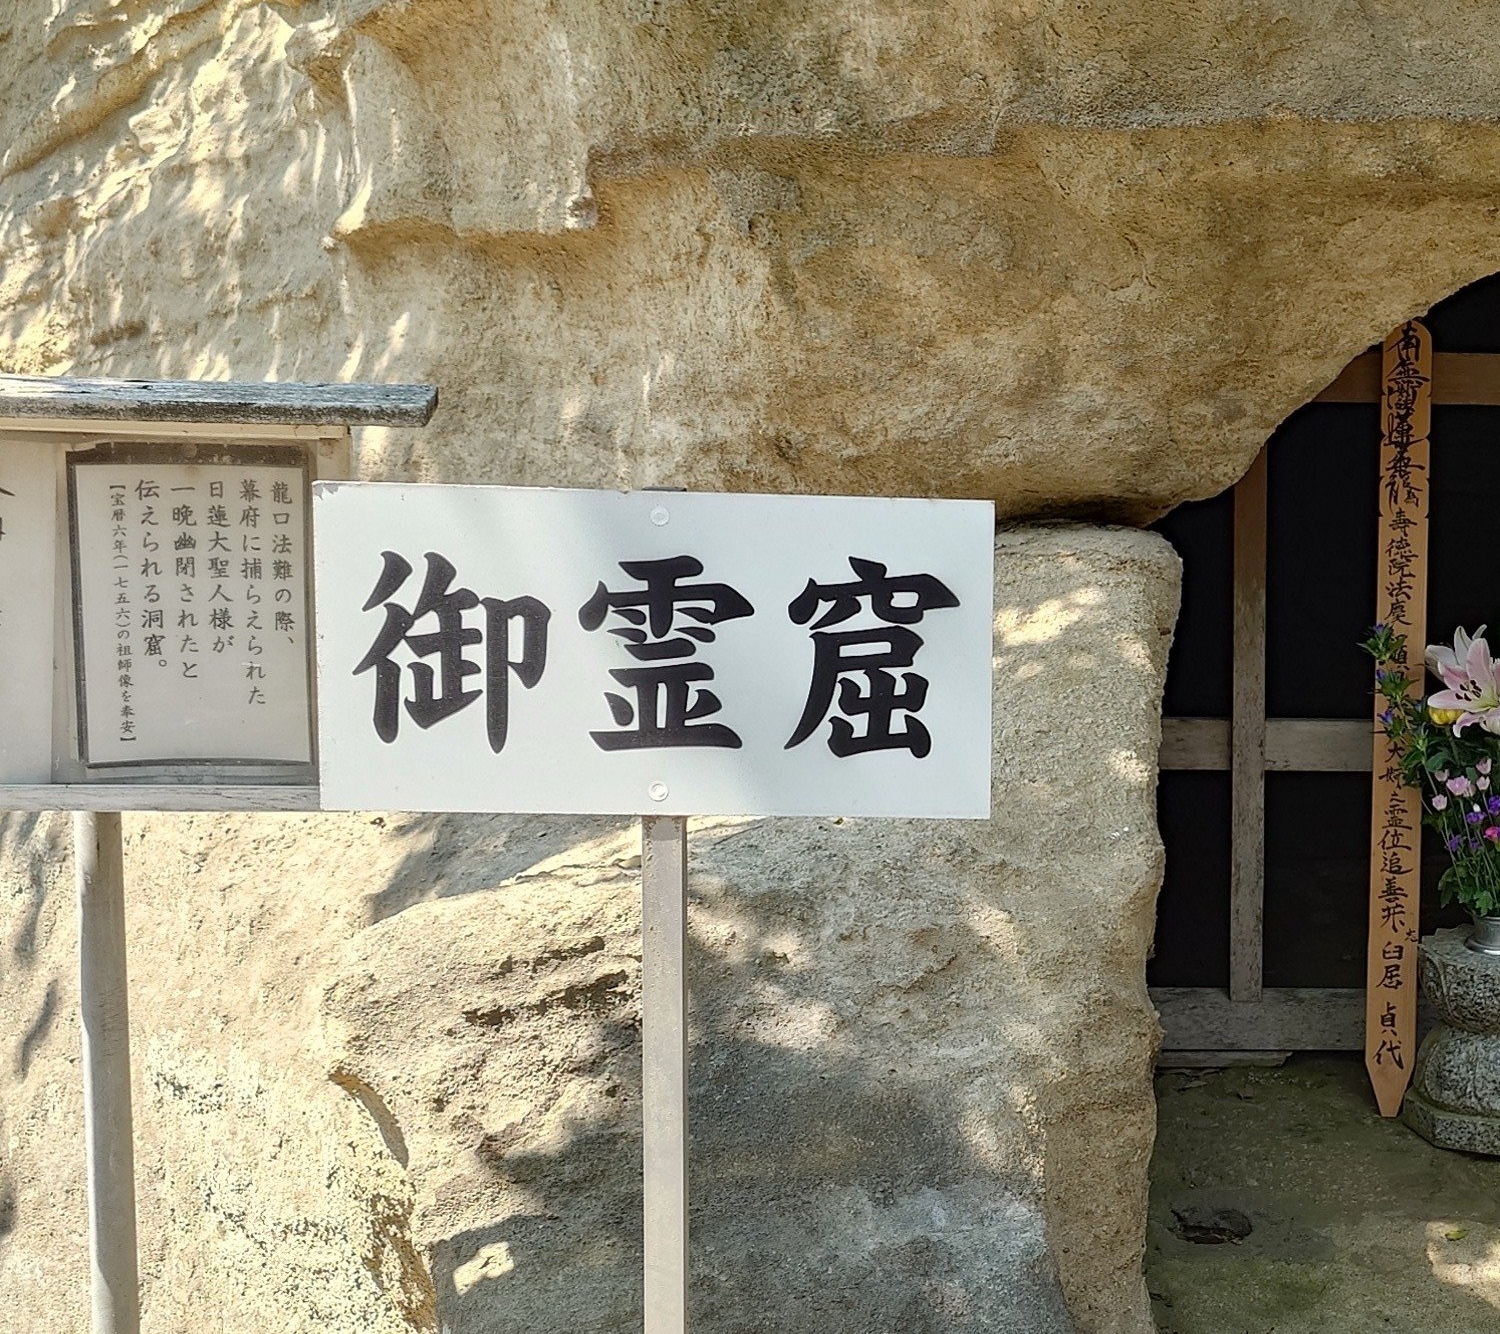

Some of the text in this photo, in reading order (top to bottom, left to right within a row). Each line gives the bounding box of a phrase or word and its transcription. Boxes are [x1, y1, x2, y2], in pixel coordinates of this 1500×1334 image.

[134, 479, 168, 668] 伝えられる洞窟。
[170, 485, 200, 680] 一晩幽閉されたと
[206, 480, 235, 655] 日蓮大聖人様が
[238, 479, 267, 705] 幕府に捕らえられた
[271, 481, 297, 645] 龍口法難の際、
[352, 550, 962, 759] 御霊窟
